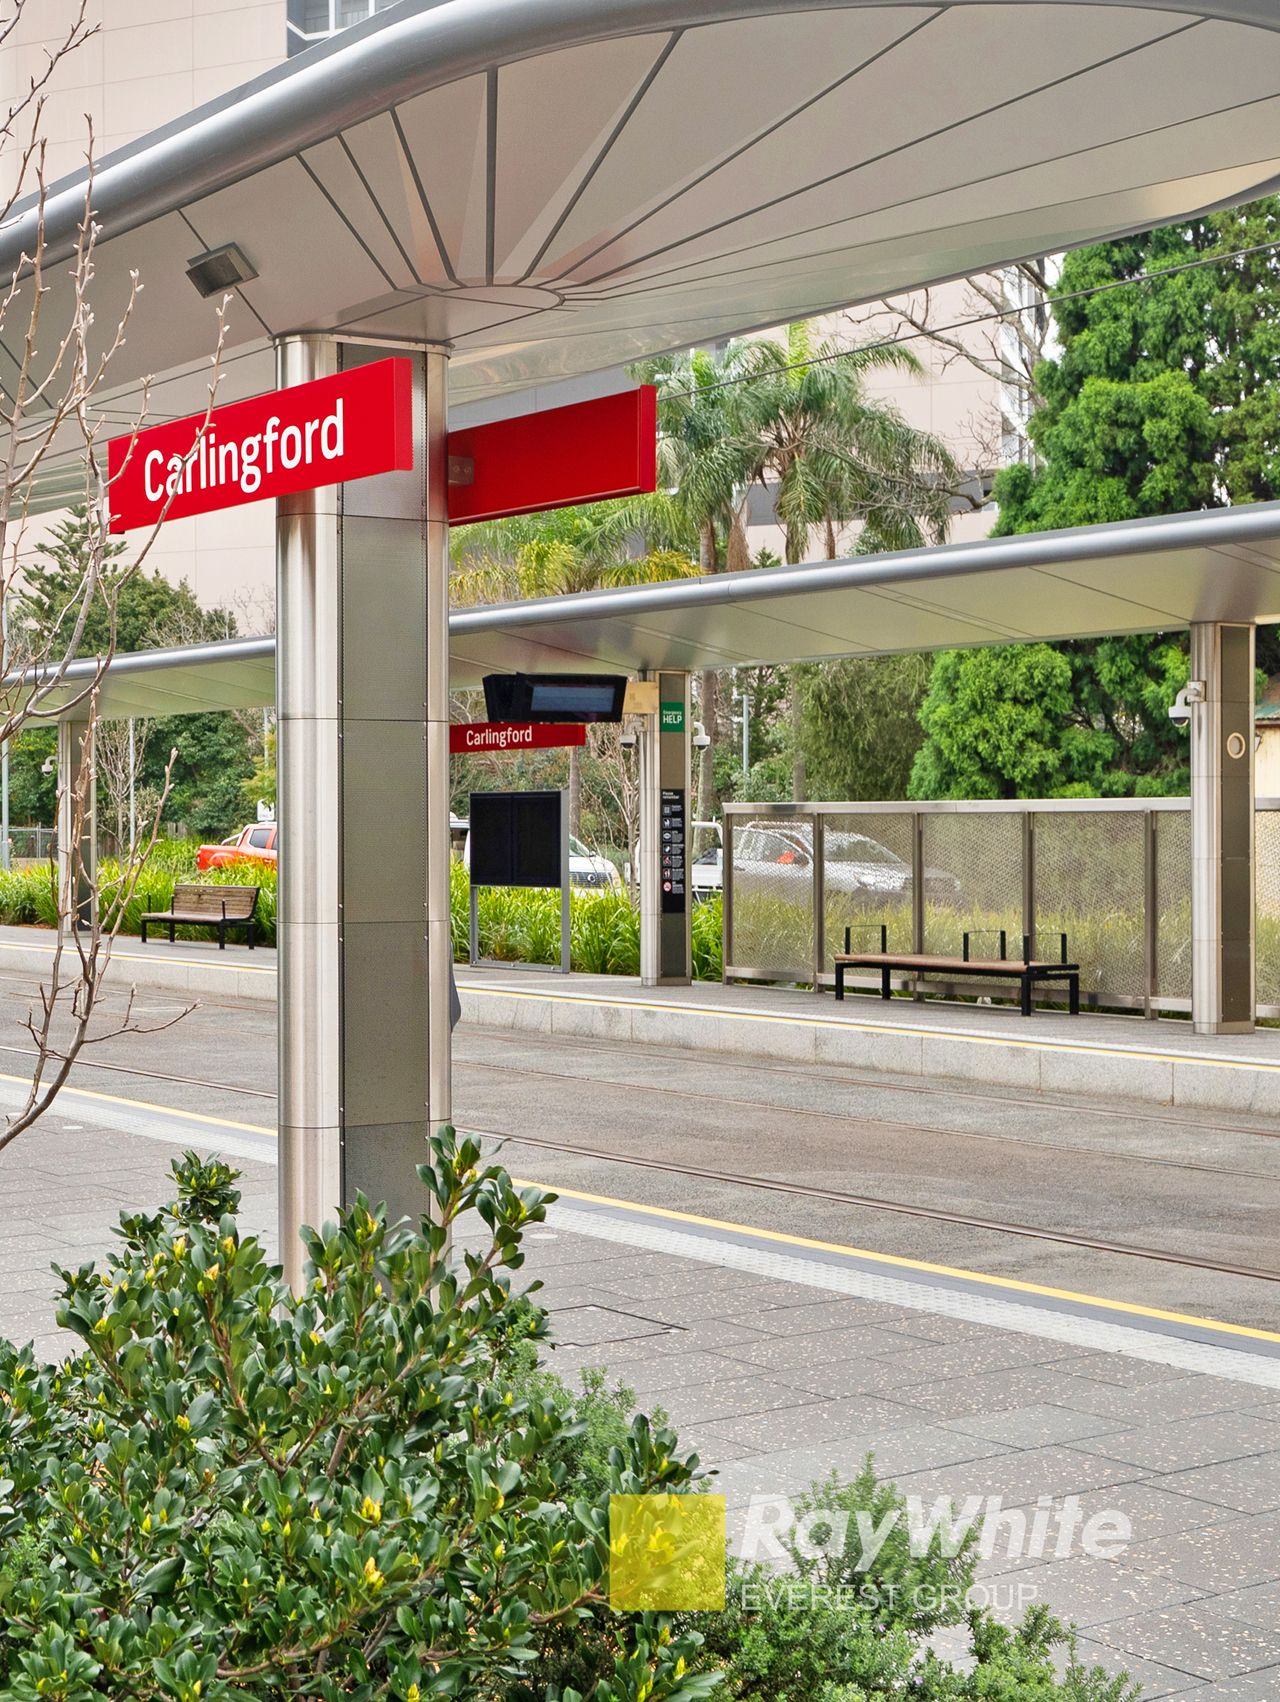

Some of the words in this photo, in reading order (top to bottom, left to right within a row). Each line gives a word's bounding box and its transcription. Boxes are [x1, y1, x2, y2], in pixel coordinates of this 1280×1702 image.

[144, 398, 344, 502] Carlingford
[663, 714, 683, 724] HELP
[466, 725, 533, 748] Carlingford
